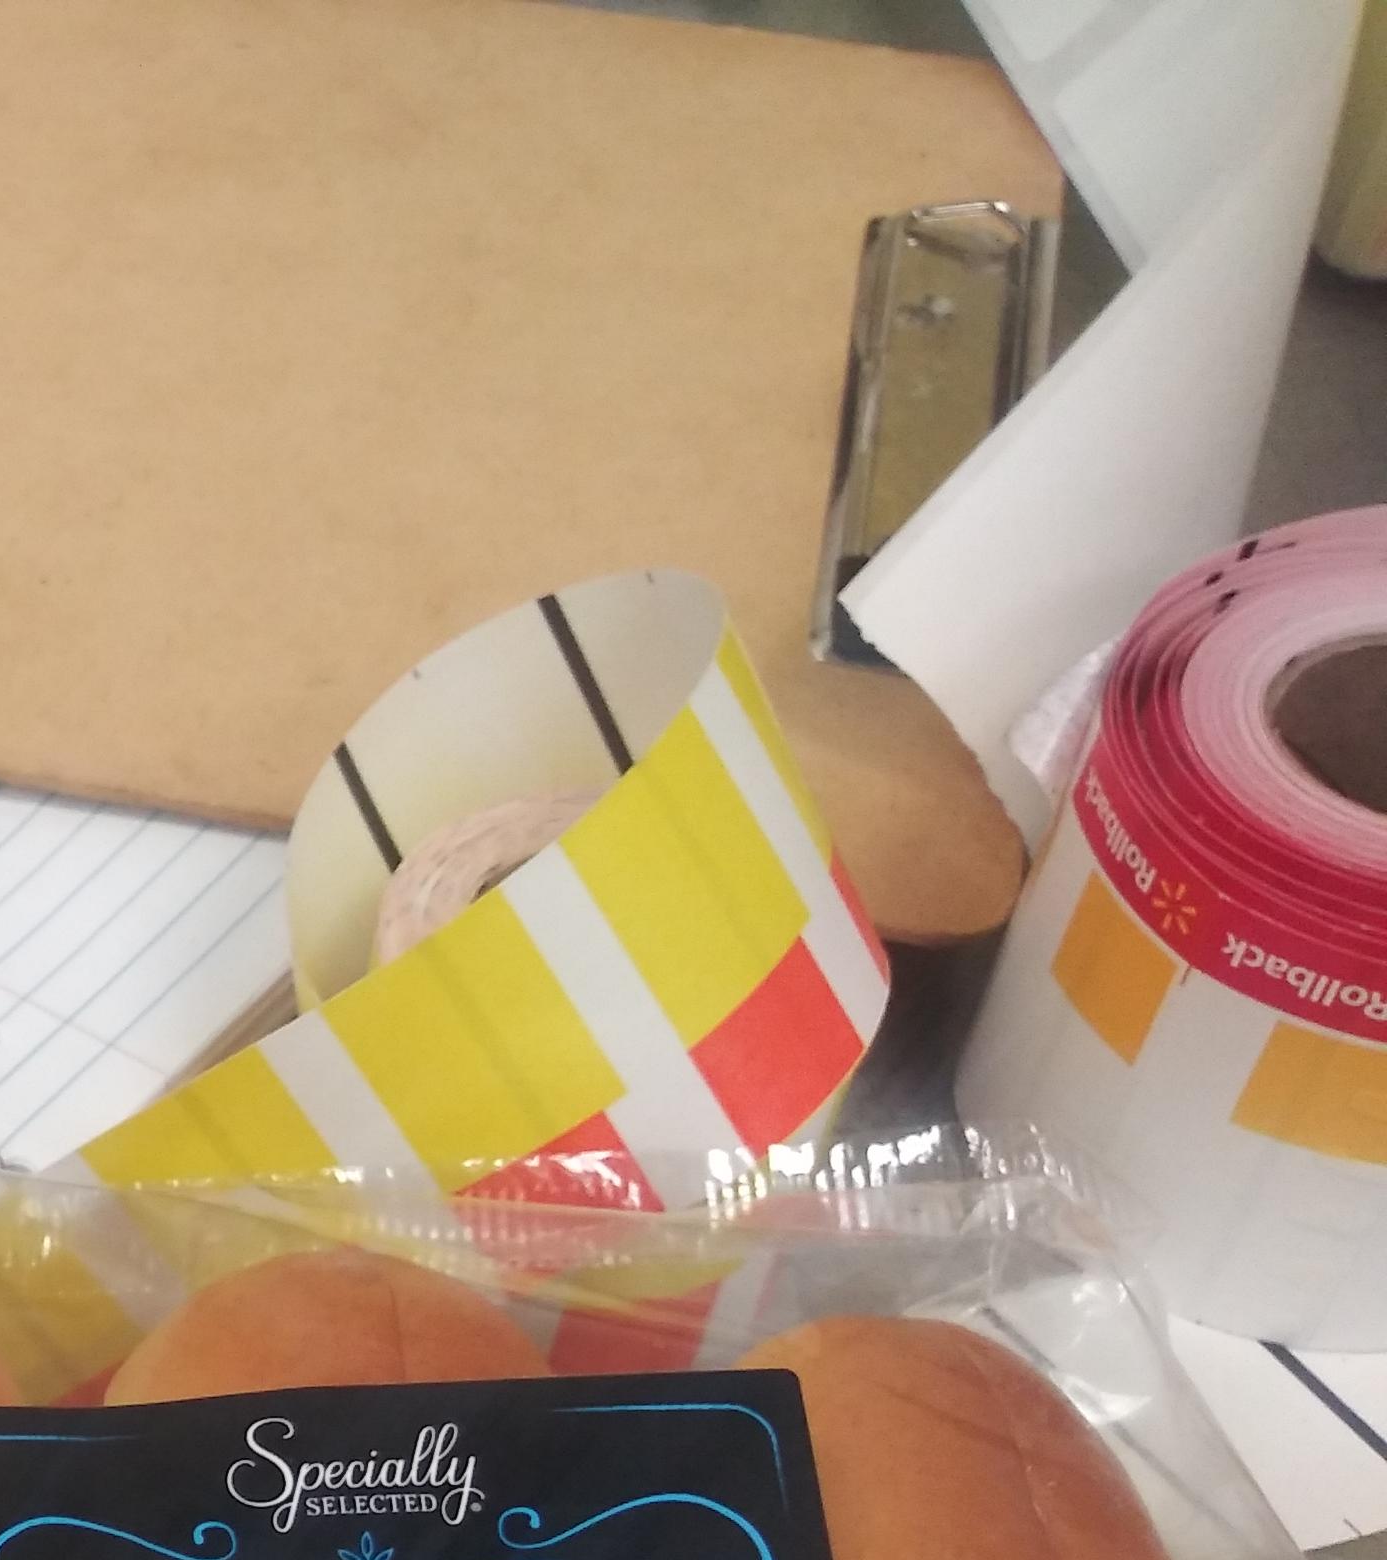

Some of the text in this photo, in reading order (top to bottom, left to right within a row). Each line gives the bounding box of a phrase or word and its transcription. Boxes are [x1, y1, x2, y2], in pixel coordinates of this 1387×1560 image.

[1220, 932, 1387, 1021] Rollback
[227, 1417, 486, 1533] Specially
[306, 1493, 438, 1516] SELECTED
